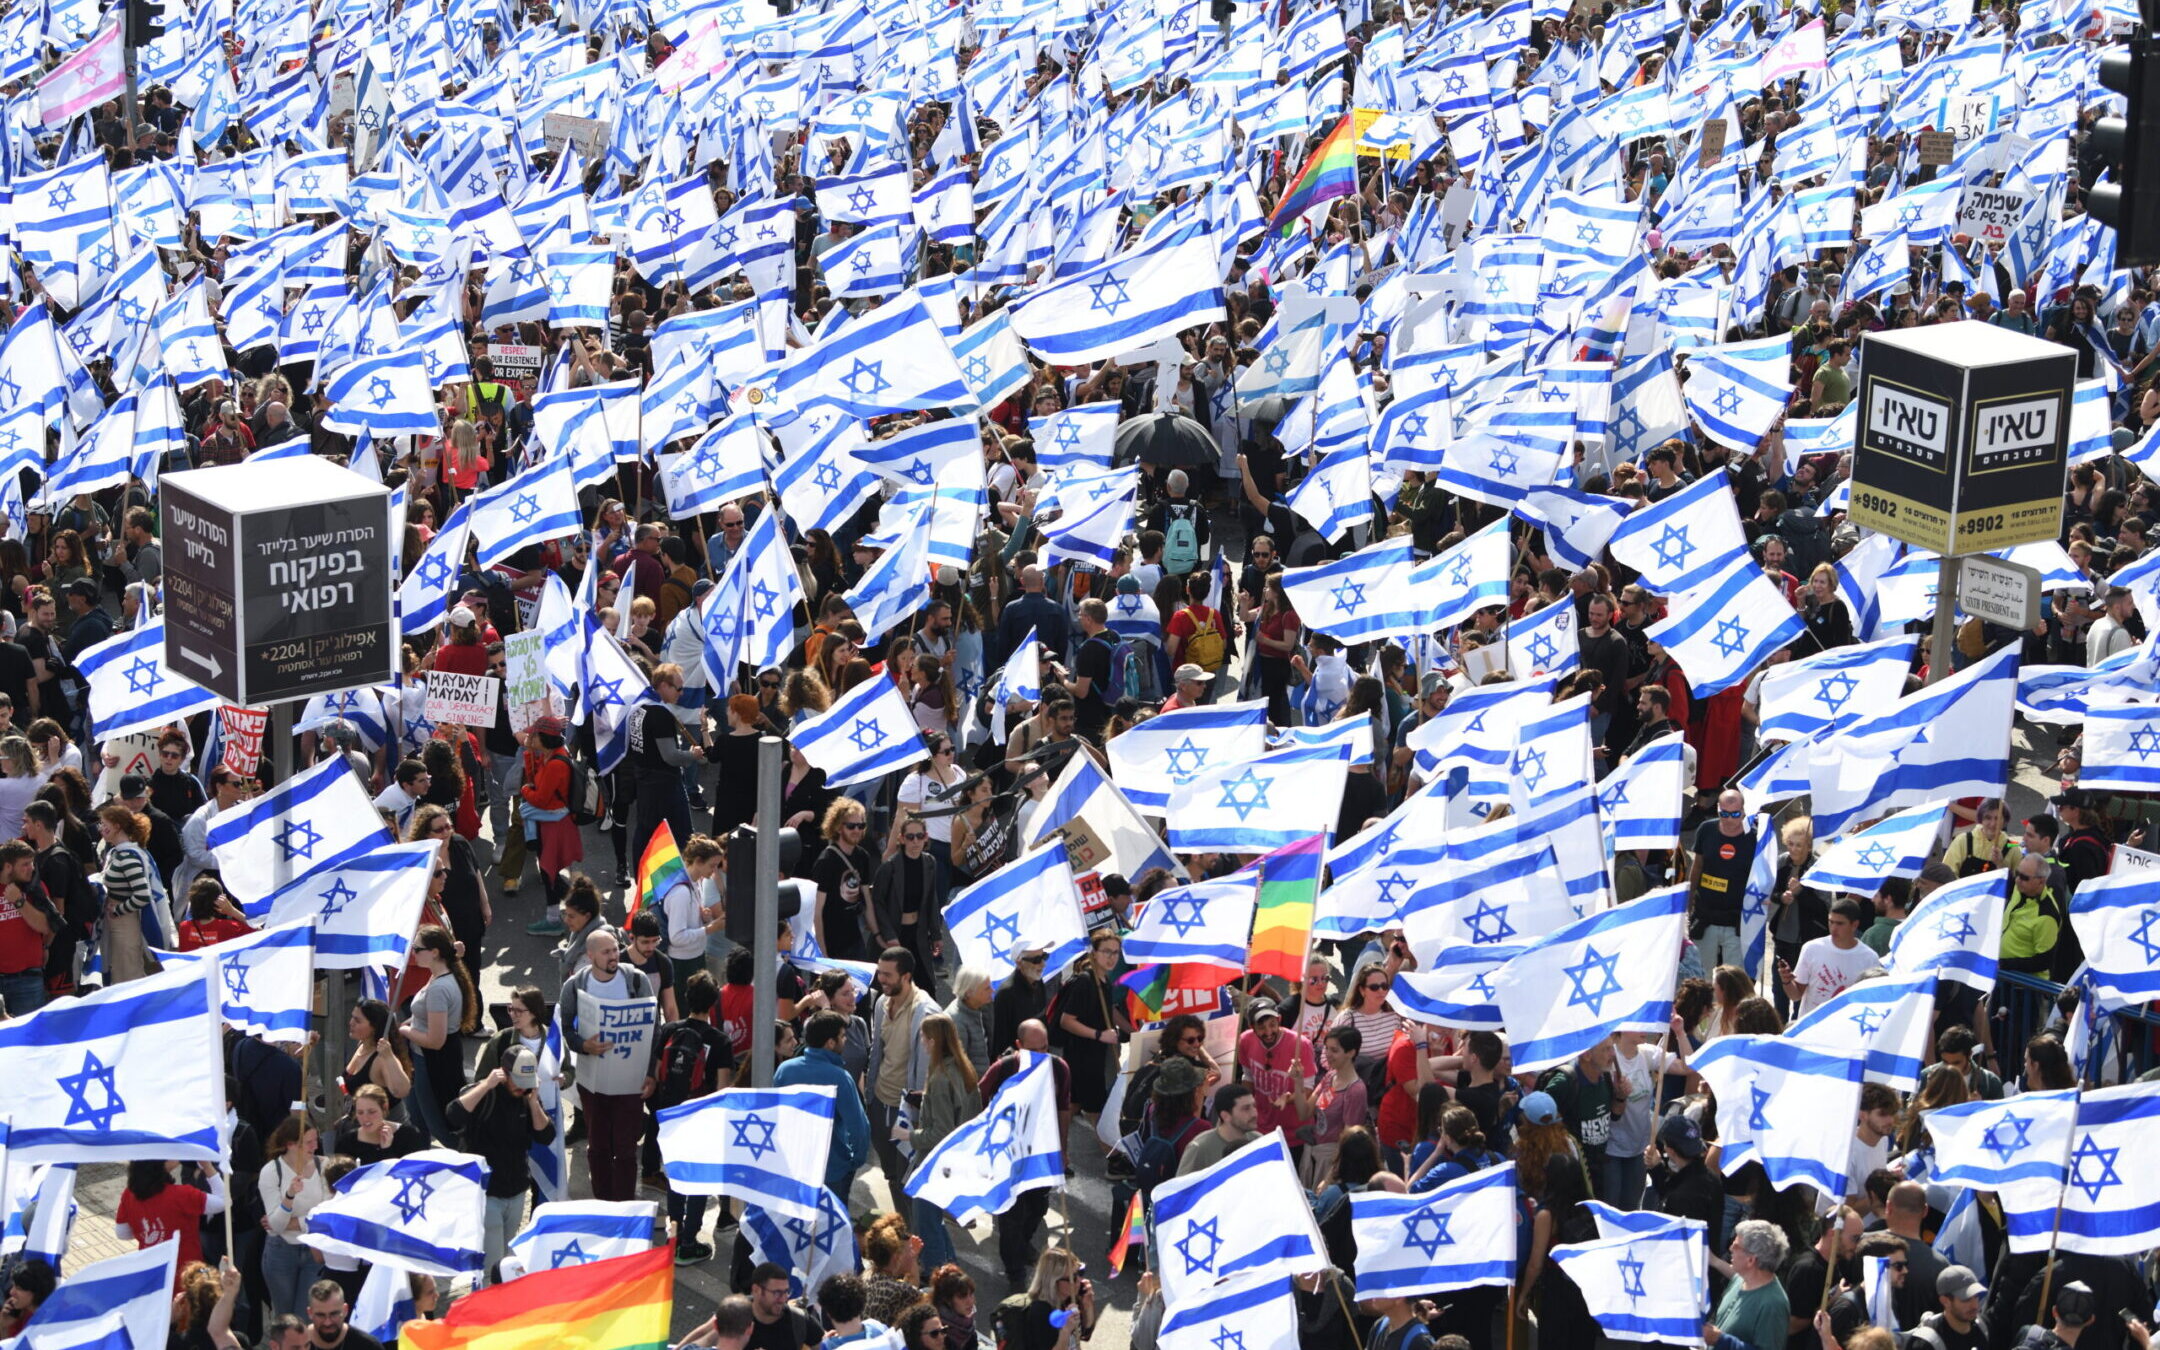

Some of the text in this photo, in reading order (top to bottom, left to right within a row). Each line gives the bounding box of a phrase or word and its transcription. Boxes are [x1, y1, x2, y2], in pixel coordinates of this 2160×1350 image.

[1971, 191, 2023, 212] שמחה
[1982, 225, 2005, 238] בת
[500, 346, 528, 355] RESPECT
[505, 356, 538, 365] EXISTENCE
[494, 367, 505, 377] OR
[1877, 435, 1934, 461] מטבחים
[1982, 448, 2043, 465] מטבחים
[170, 504, 227, 547] הסרת שיער
[257, 526, 374, 555] הסרת שיער בלייזר
[184, 538, 215, 569] בלייזר
[270, 550, 364, 588] בפיקוח
[282, 582, 354, 614] רפואי
[1965, 596, 1980, 610] SIXTH
[1981, 599, 2010, 617] PRESIDENT
[334, 651, 363, 663] רפואת
[430, 673, 482, 689] MAYDAY
[427, 687, 478, 703] MAYDAY
[426, 700, 495, 714] OUR DEMOCRACY
[426, 710, 484, 724] IS SINKING
